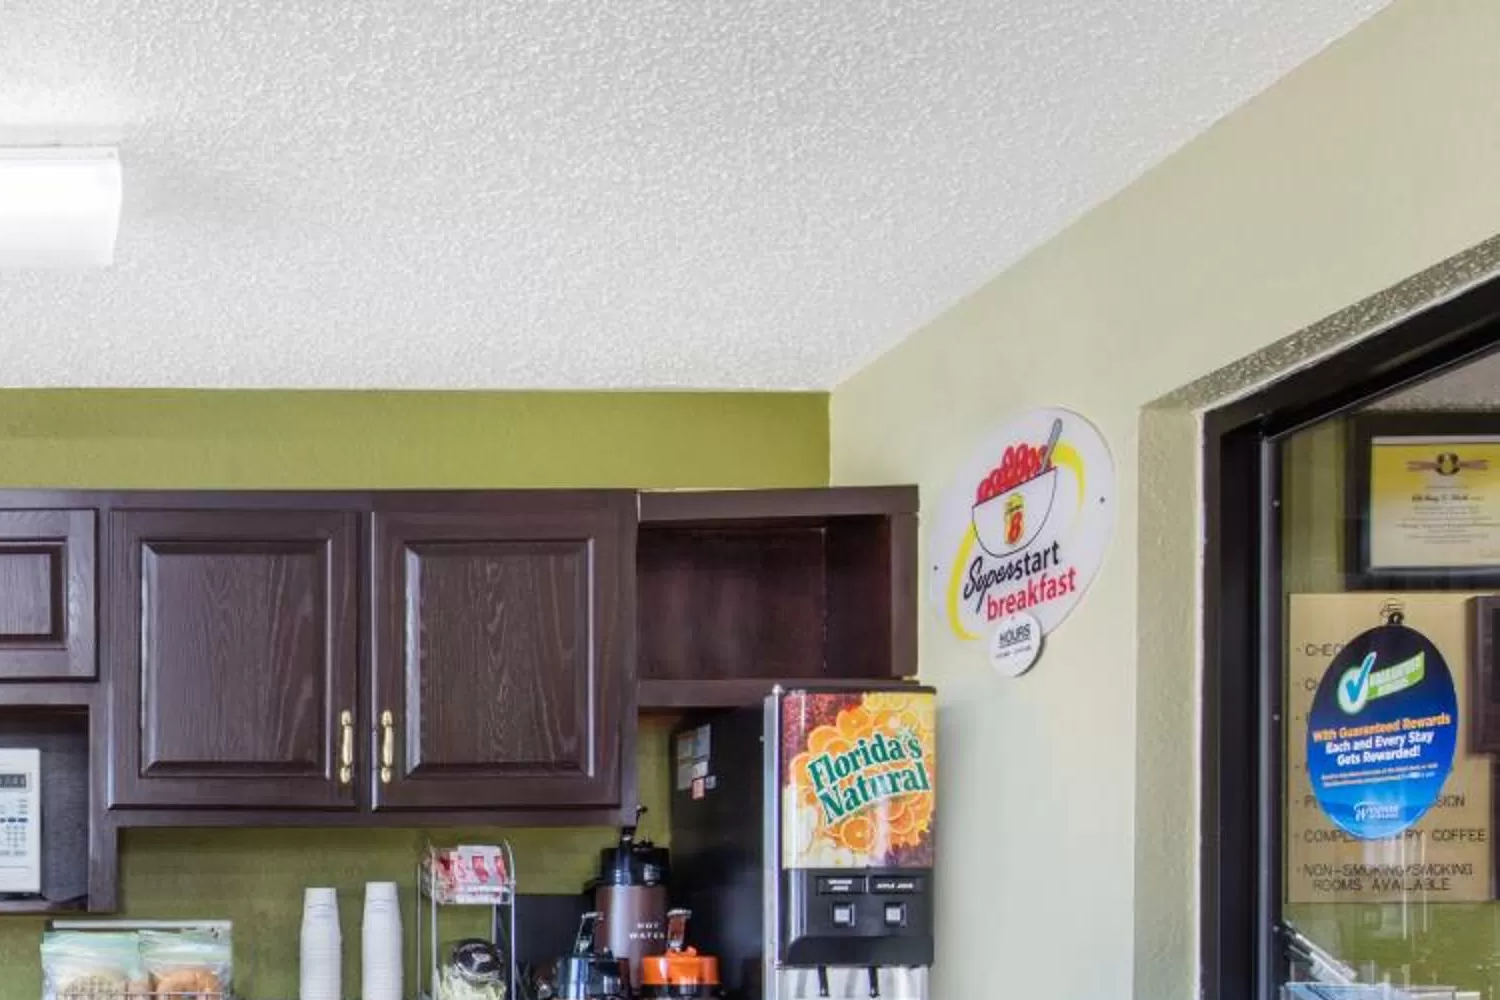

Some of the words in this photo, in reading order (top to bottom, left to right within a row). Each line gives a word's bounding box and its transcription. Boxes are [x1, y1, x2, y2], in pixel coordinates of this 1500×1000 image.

[964, 541, 1060, 614] Superstart
[987, 567, 1077, 621] breakfast
[999, 623, 1031, 644] HOURS
[1339, 719, 1401, 739] Guaranteed
[1402, 712, 1452, 731] Rewards
[1325, 740, 1351, 755] Each
[1353, 736, 1373, 750] and
[1375, 733, 1407, 750] Every
[1408, 730, 1435, 746] Stay
[1337, 751, 1361, 766] Gets
[1363, 745, 1421, 763] Rewarded!
[807, 734, 923, 791] Florida's
[819, 762, 930, 824] Natural
[1431, 828, 1488, 843] COFFEE
[1313, 877, 1363, 892] ROOMS
[1371, 877, 1452, 892] AVAILABLE
